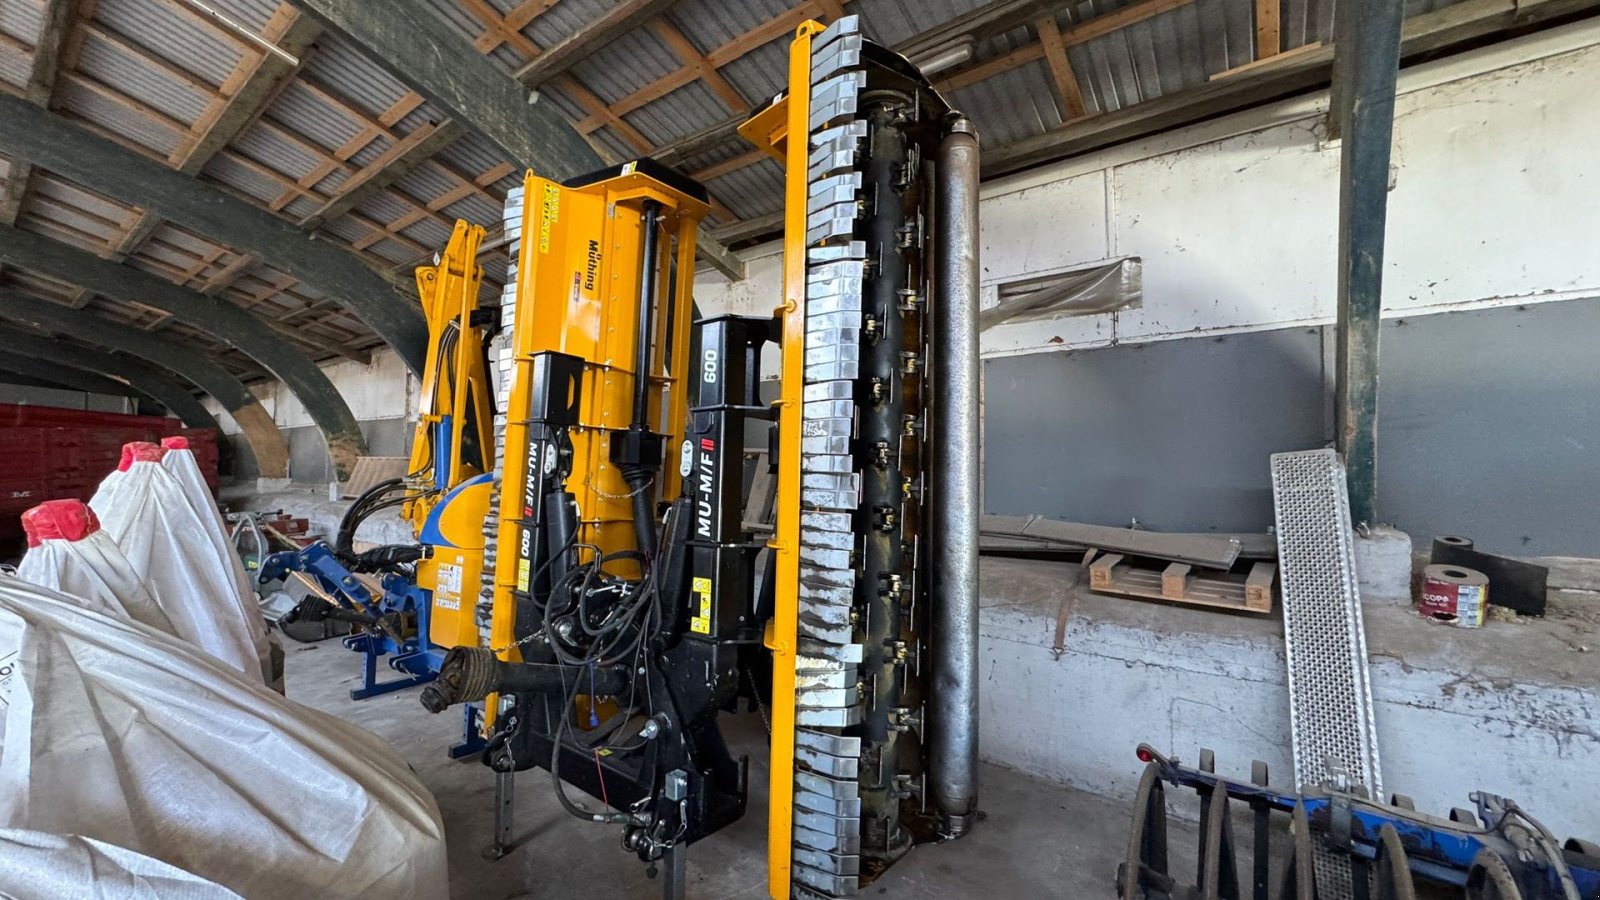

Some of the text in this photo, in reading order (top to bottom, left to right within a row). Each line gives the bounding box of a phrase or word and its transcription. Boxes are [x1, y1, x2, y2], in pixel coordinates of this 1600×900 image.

[585, 240, 603, 291] Müthing
[704, 350, 717, 384] 600
[521, 529, 531, 557] 600
